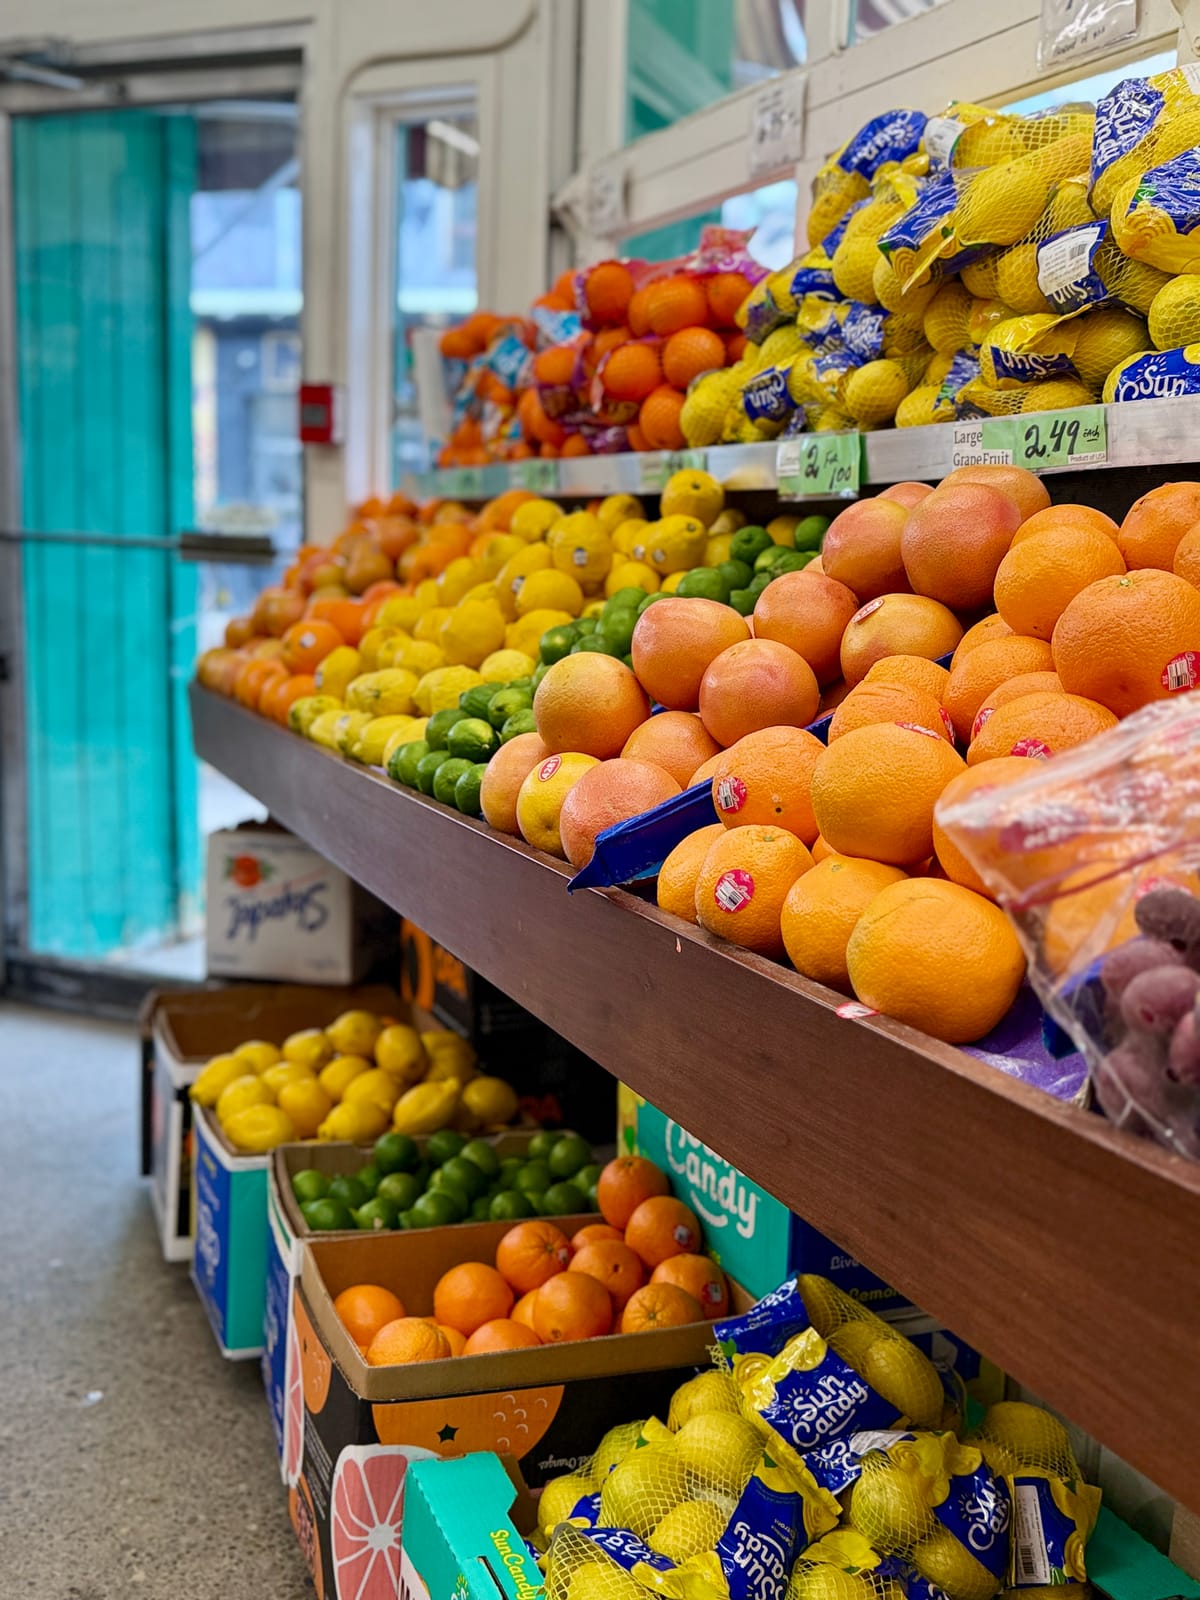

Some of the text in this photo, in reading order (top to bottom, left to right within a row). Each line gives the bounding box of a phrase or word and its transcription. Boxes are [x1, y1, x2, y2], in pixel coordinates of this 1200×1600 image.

[1139, 365, 1185, 397] Sun
[954, 430, 983, 447] Large
[1024, 419, 1080, 459] 2.49
[665, 1118, 757, 1239] Candy
[792, 1380, 869, 1447] Candy
[793, 1375, 845, 1421] Sun
